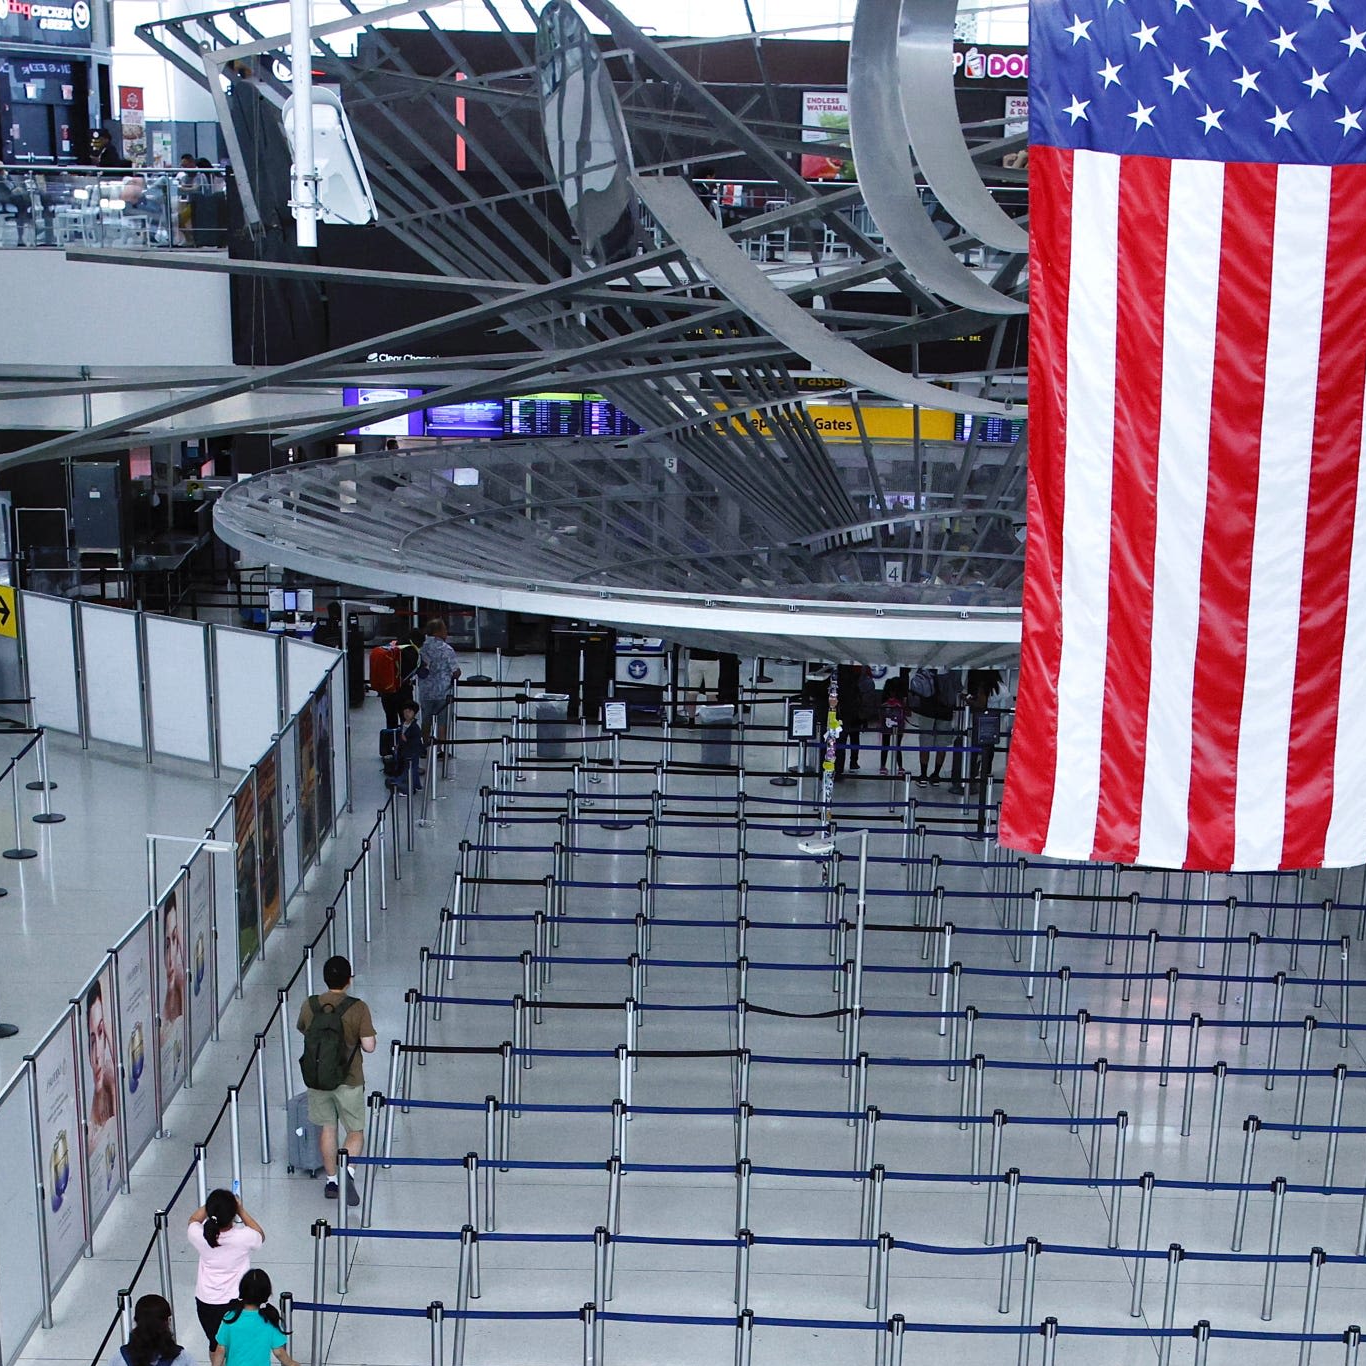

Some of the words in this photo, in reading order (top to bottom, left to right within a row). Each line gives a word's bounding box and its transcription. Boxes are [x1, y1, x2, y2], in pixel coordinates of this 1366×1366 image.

[807, 97, 840, 105] ENDLESS
[807, 104, 847, 112] WATERMEL
[815, 417, 852, 431] Gates
[668, 458, 674, 468] 5
[889, 566, 899, 581] 4
